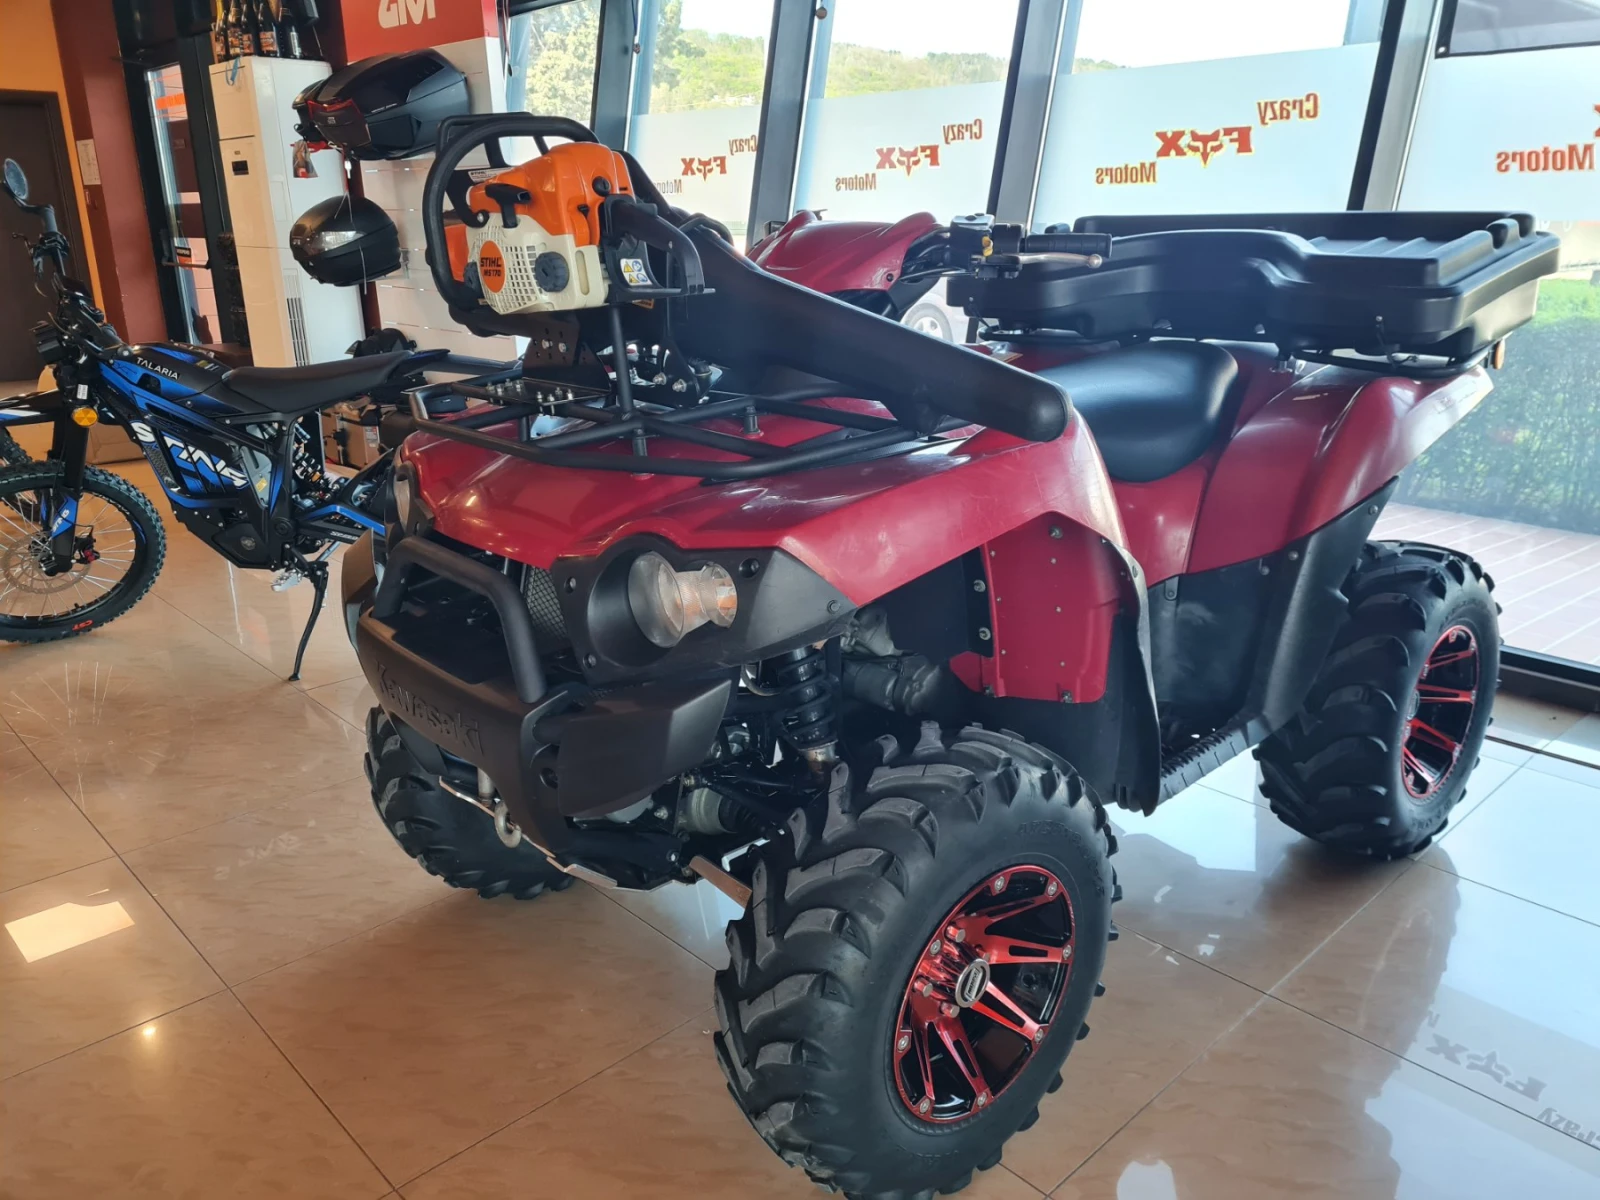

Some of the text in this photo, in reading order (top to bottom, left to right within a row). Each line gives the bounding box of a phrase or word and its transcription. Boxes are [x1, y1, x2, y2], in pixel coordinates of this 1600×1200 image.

[480, 257, 502, 267] STIHL
[136, 357, 180, 380] TALARIA
[376, 660, 485, 757] Kawasaki
